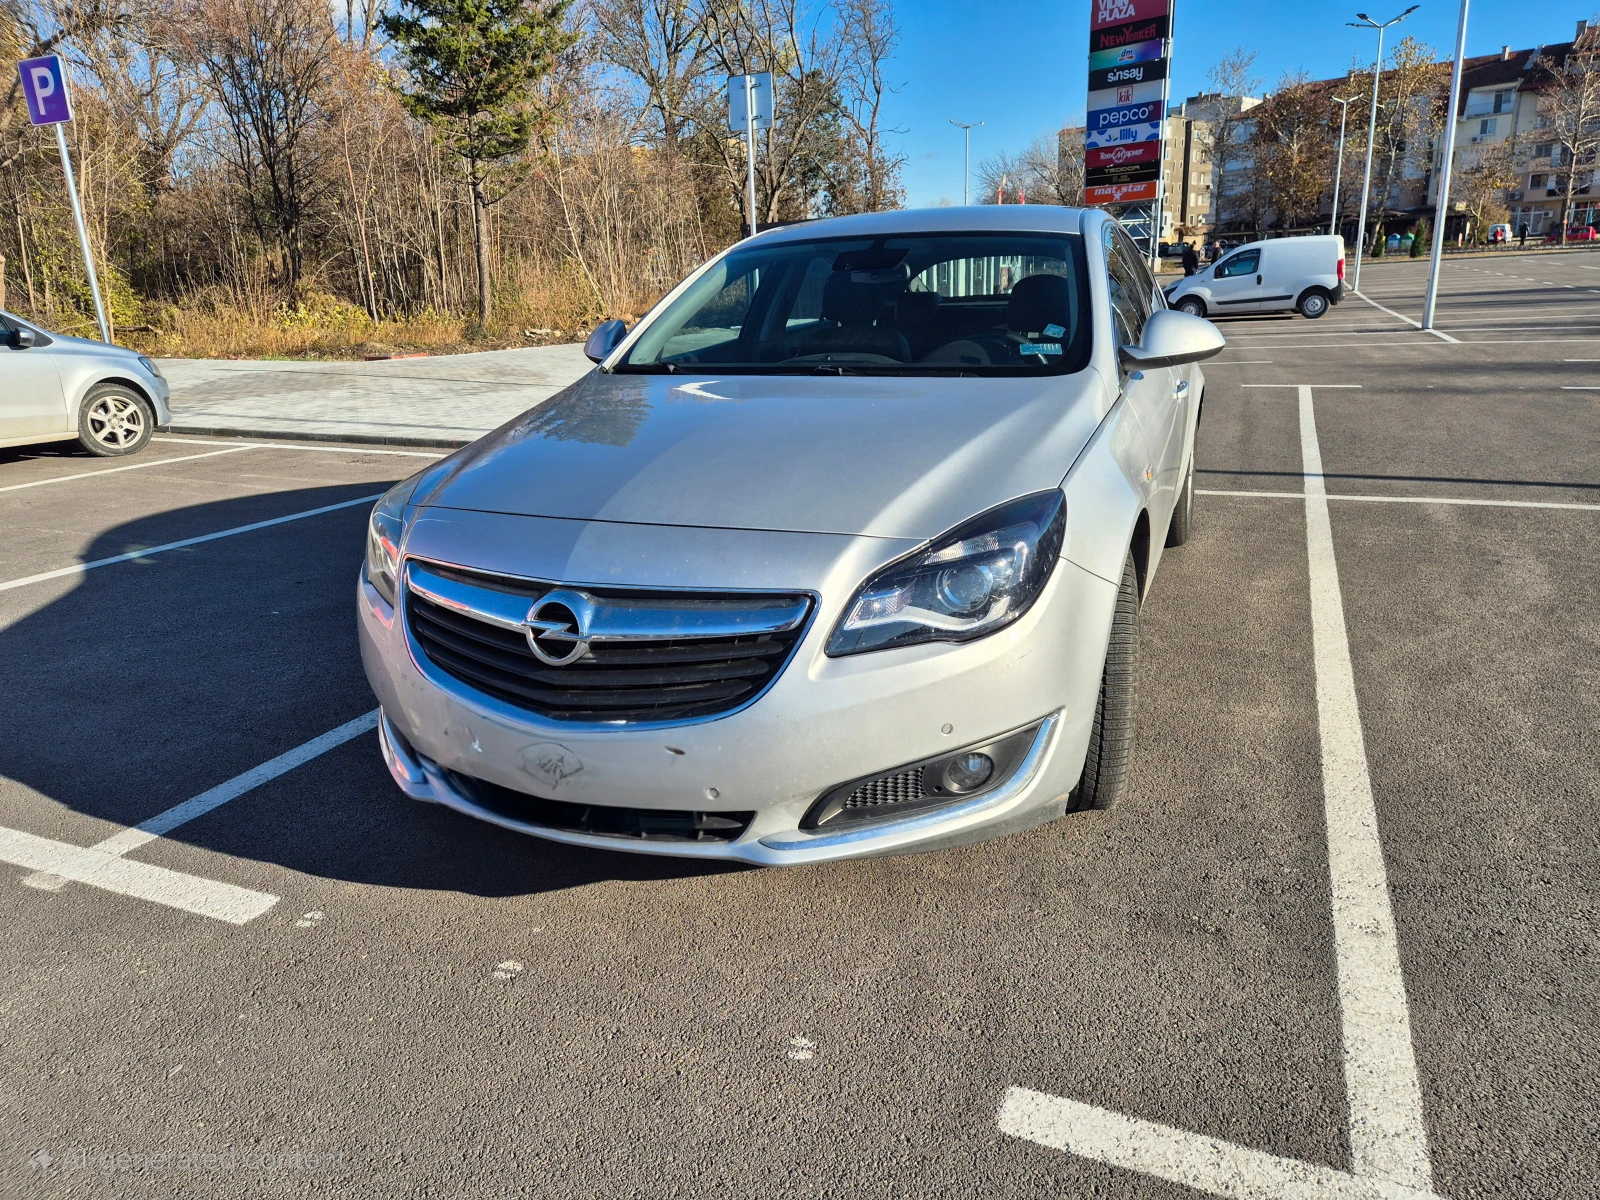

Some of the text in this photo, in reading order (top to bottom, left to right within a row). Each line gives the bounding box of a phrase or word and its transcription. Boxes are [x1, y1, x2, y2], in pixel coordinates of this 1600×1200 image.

[1098, 4, 1135, 23] PLAZA
[1121, 49, 1133, 57] dm
[1107, 67, 1143, 82] sinsay
[30, 67, 54, 115] P
[1118, 89, 1131, 103] kik
[1120, 128, 1137, 142] lilly
